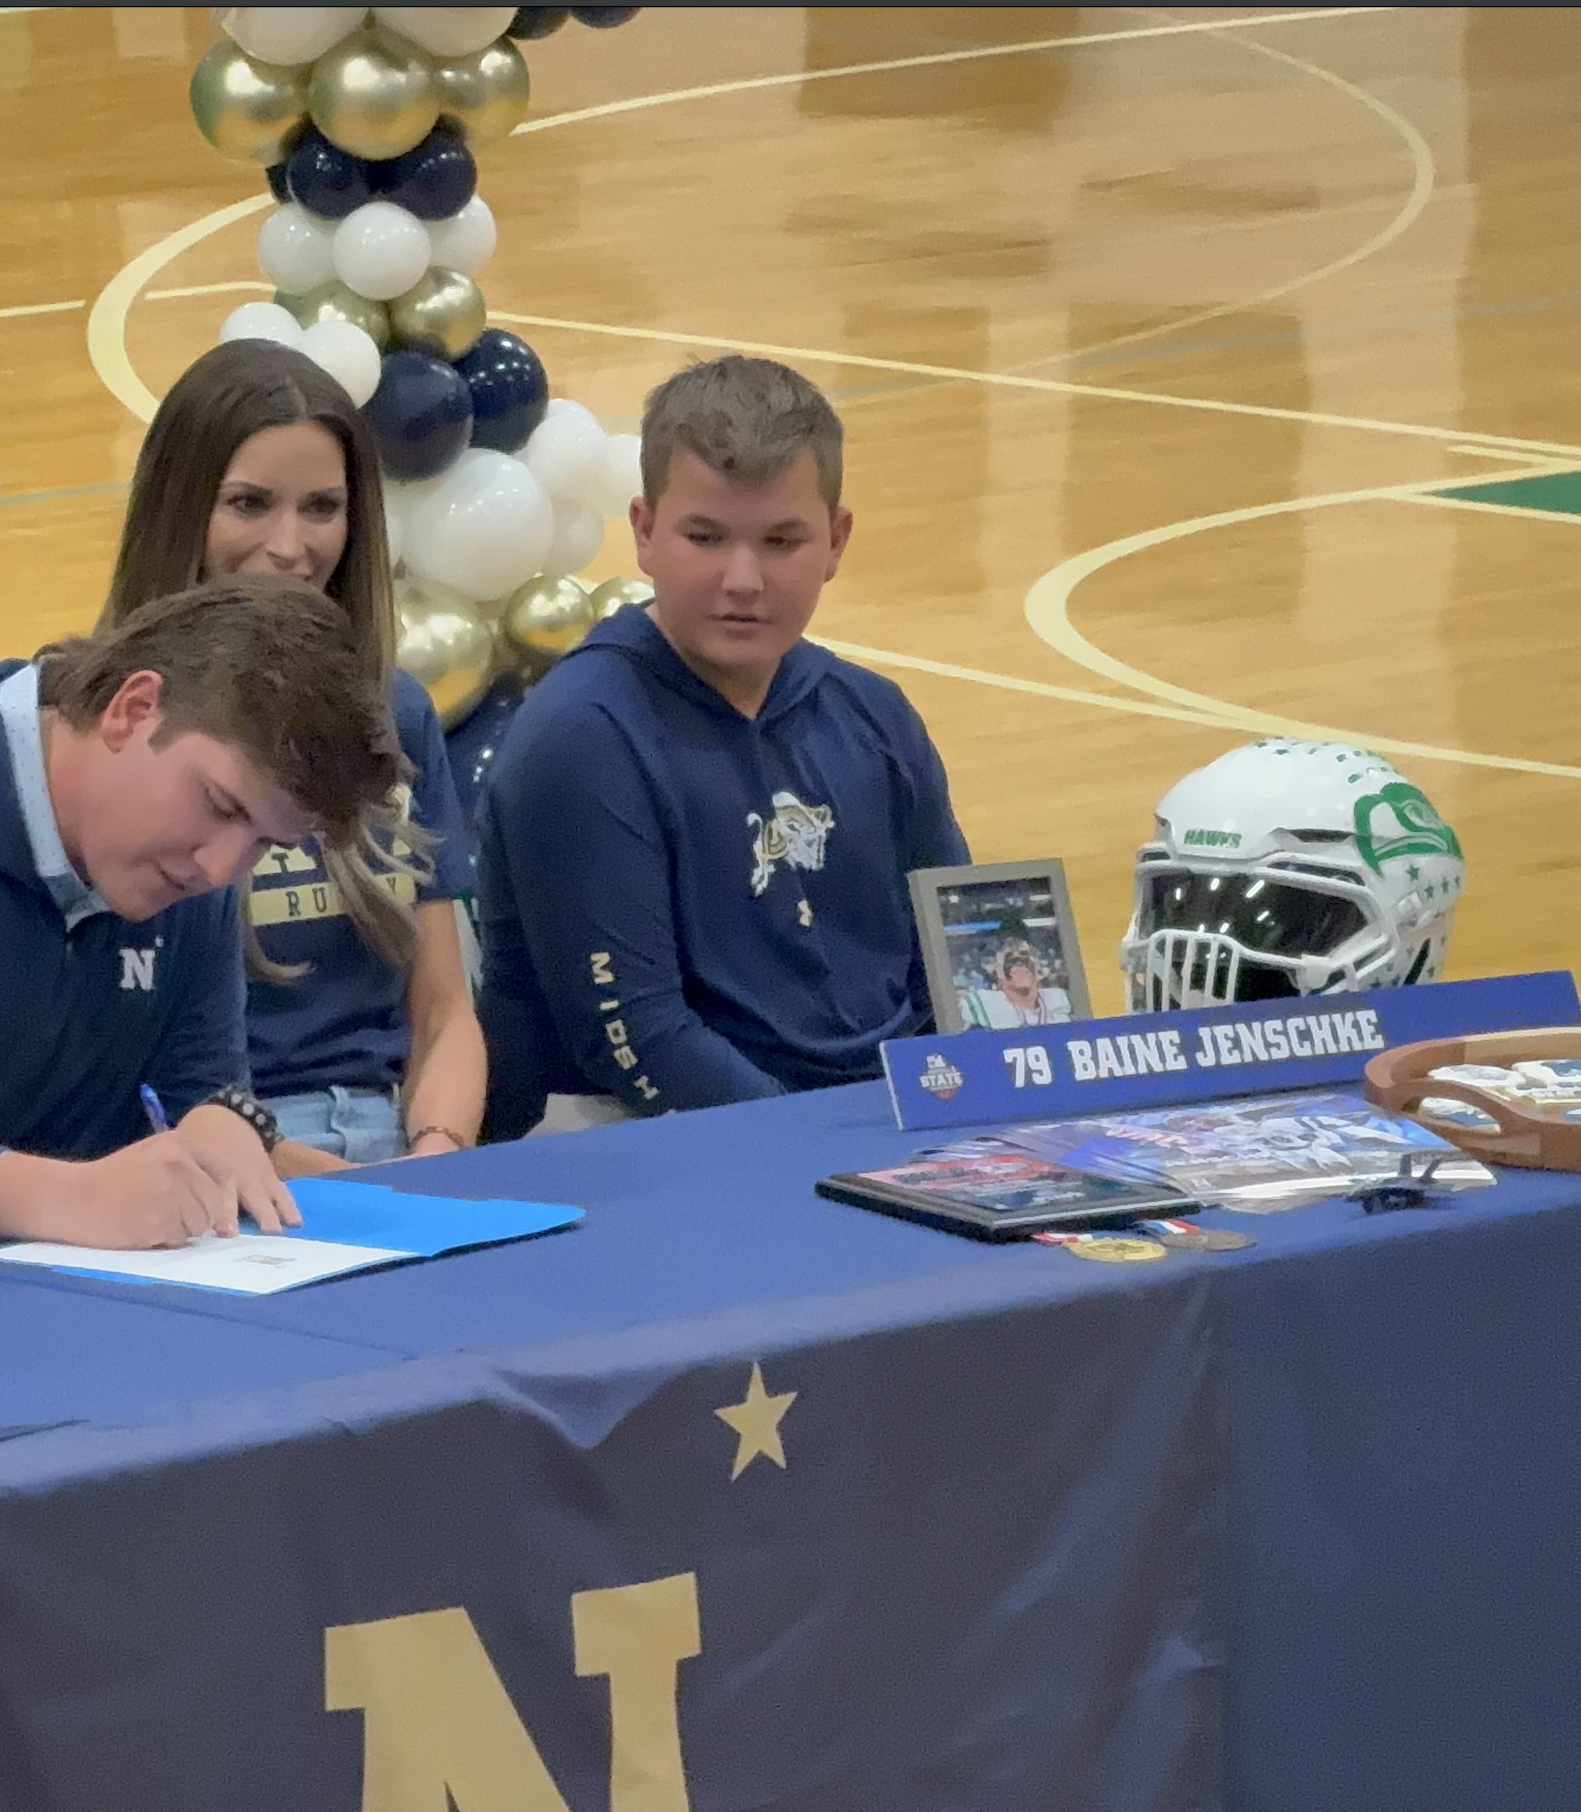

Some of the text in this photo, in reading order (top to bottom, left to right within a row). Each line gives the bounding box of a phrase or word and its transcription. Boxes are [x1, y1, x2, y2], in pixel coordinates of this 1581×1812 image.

[119, 948, 156, 991] N
[589, 951, 660, 1100] MIDSH
[1003, 1009, 1385, 1088] 79 BAINE JENSCHKE
[920, 1071, 964, 1088] STATE
[324, 1572, 702, 1812] N
